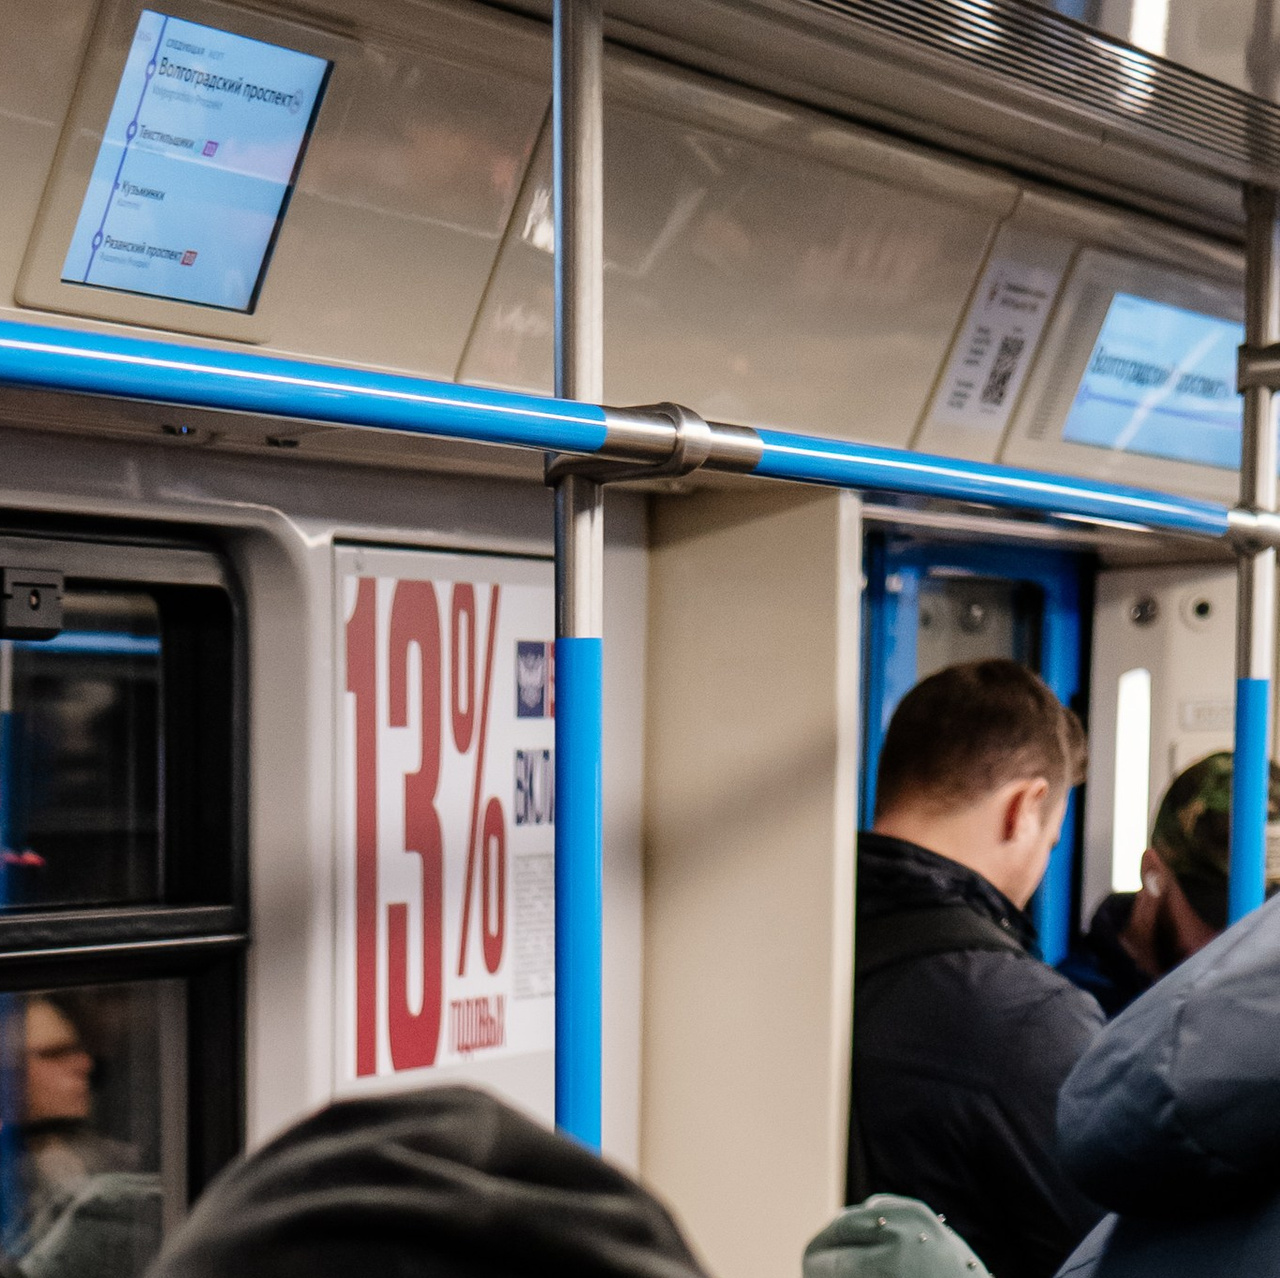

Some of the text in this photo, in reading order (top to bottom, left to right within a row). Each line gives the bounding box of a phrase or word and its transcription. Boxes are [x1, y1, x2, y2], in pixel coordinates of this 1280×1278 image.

[158, 56, 243, 96] Волгоградский
[242, 81, 294, 107] проспект
[146, 243, 183, 260] проспект
[346, 576, 507, 1077] 13%
